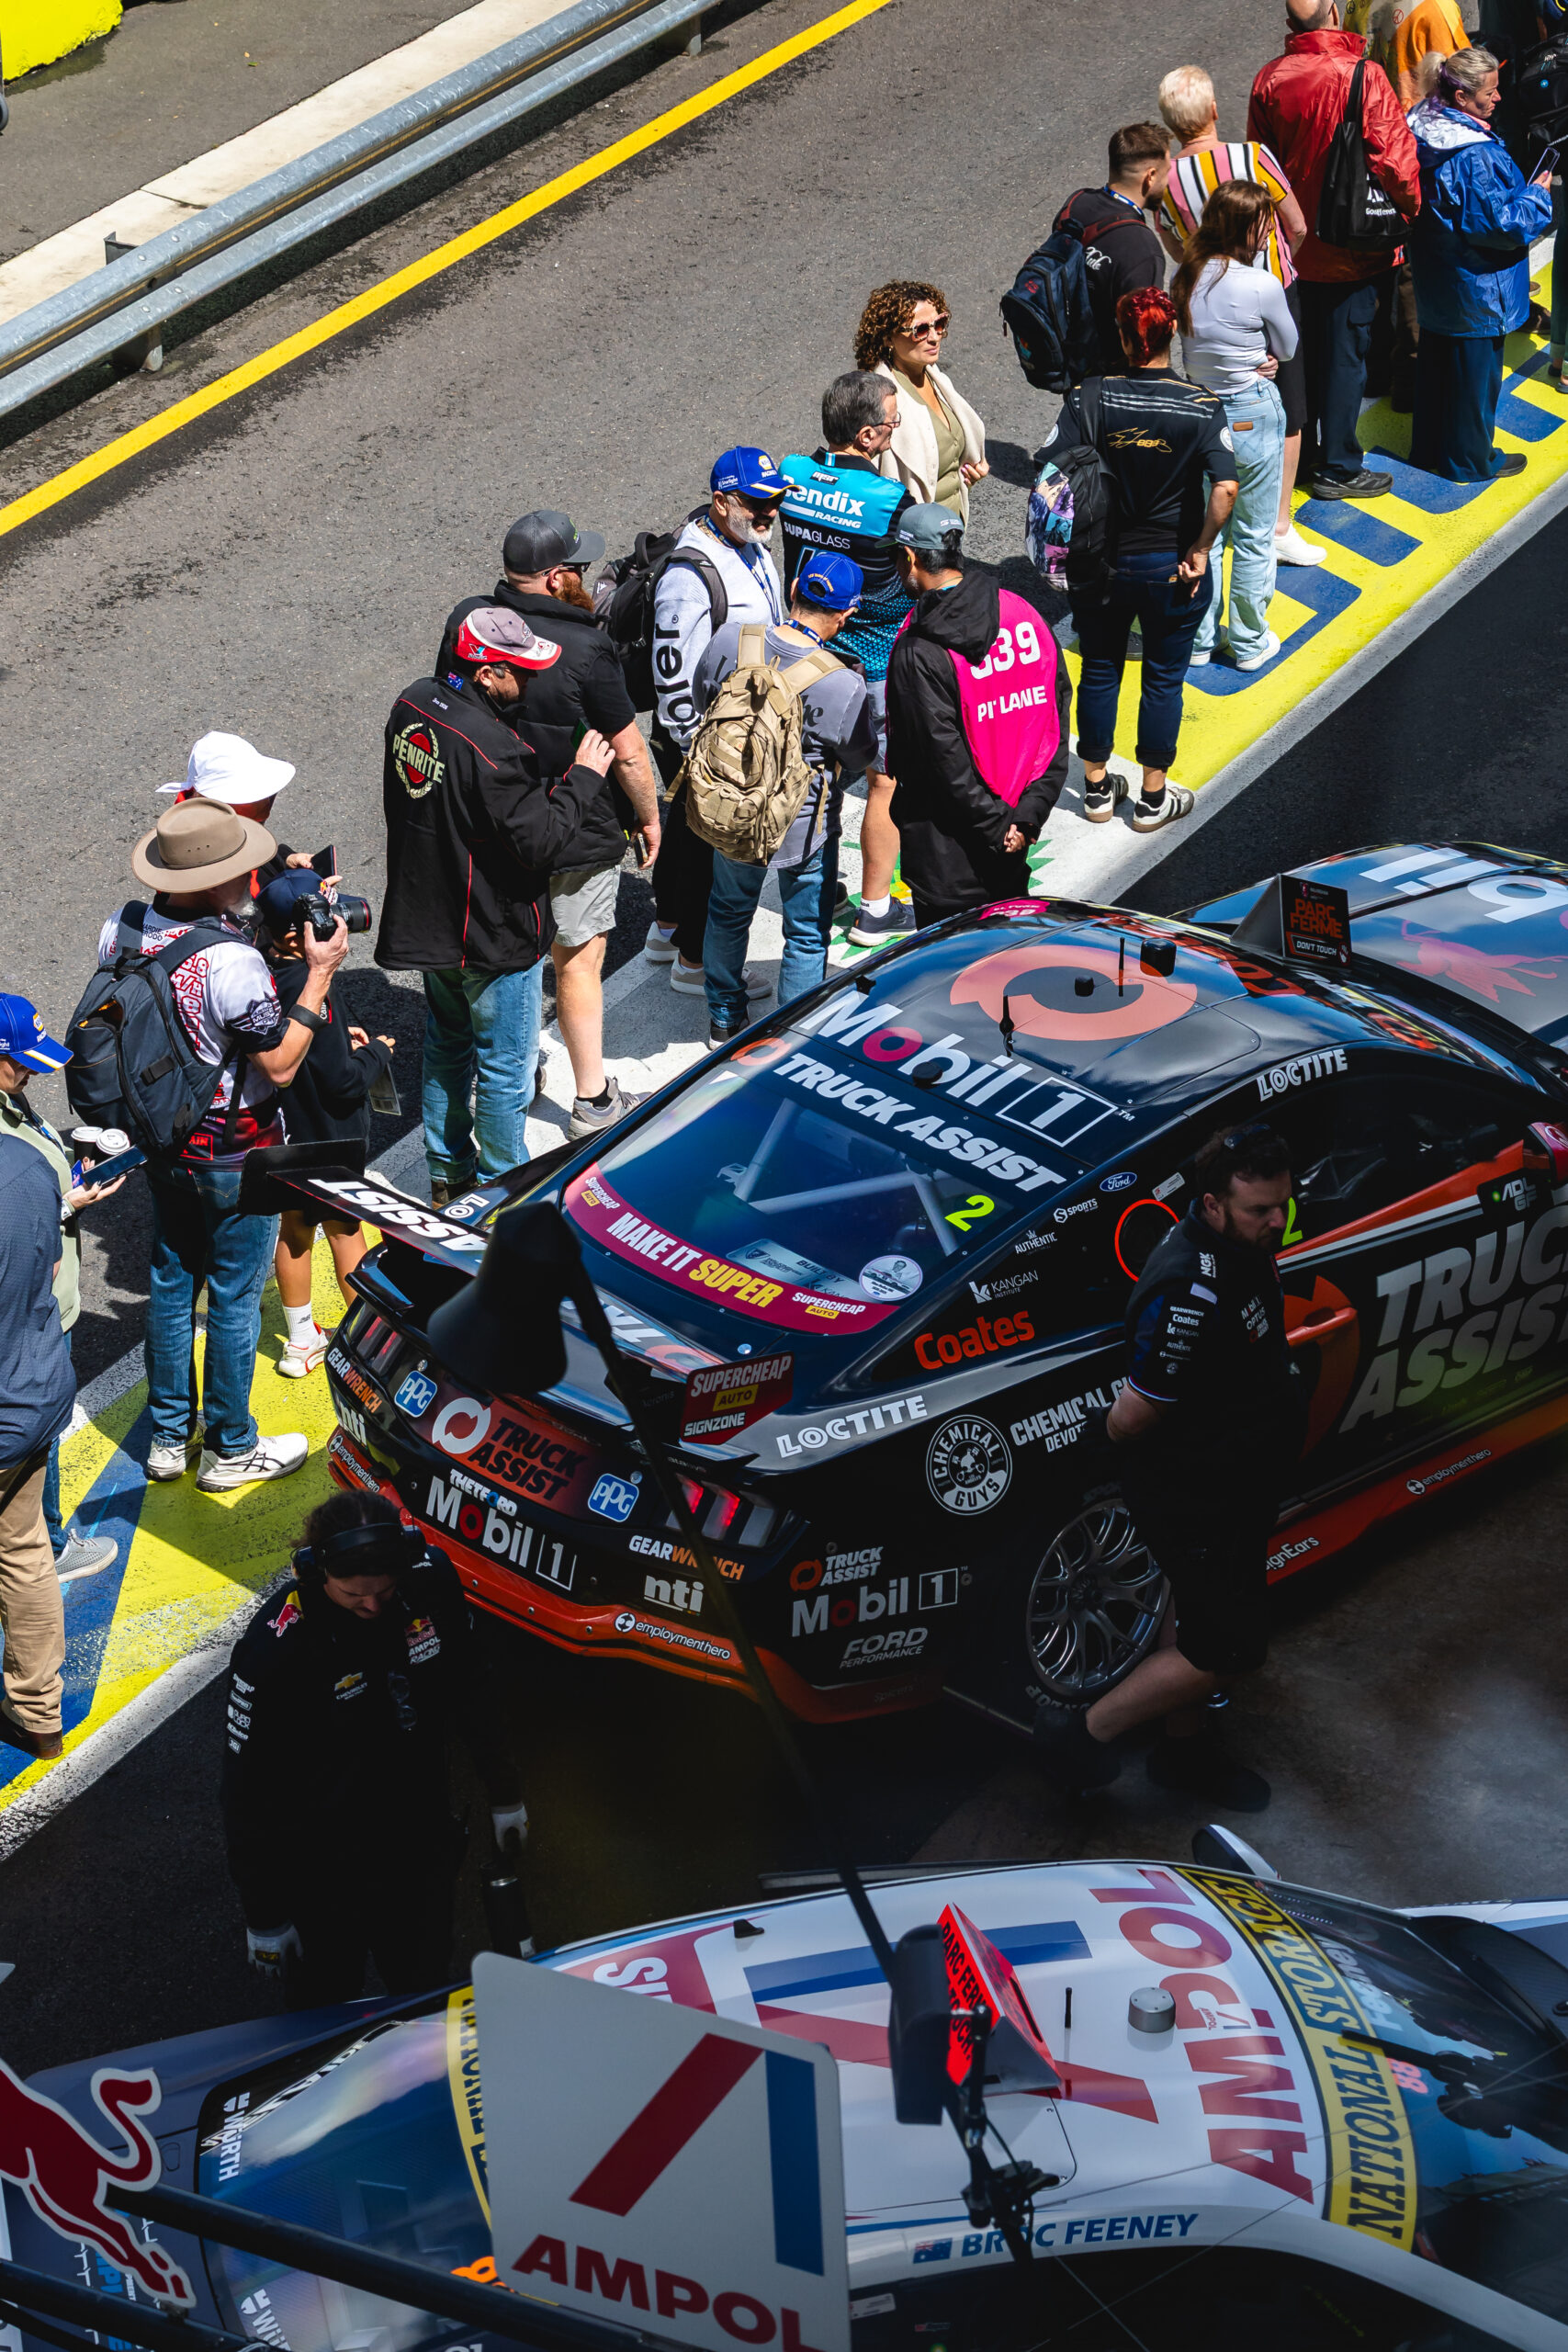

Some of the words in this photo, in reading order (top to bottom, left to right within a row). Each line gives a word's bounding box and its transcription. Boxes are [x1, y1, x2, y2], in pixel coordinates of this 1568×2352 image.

[784, 521, 851, 549] SUPAGLASS
[814, 511, 862, 529] RACING
[999, 685, 1048, 714] LANE
[392, 733, 446, 785] PENRITE
[1290, 912, 1343, 939] FERME
[1294, 899, 1336, 922] PARC
[1296, 940, 1315, 951] DON'T
[1316, 944, 1337, 956] TOUCH
[799, 990, 1033, 1107] Mobil
[1030, 1091, 1087, 1130] 1
[1256, 1048, 1348, 1102] LOCTITE
[773, 1053, 916, 1125] TRUCK
[894, 1114, 1067, 1192] ASSIST
[584, 1192, 598, 1204] AUTO
[585, 1176, 621, 1210] SUPERCHEAP
[1106, 1175, 1131, 1191] Ford
[308, 1179, 489, 1251] ASSIST
[944, 1194, 995, 1232] 2
[1067, 1198, 1098, 1216] SPORTS
[606, 1212, 671, 1263] MAKE
[660, 1244, 703, 1272] IT
[689, 1258, 784, 1308] SUPER
[1014, 1231, 1057, 1255] AUTHENTIC
[1199, 1251, 1213, 1278] NGK
[1377, 1204, 1568, 1347] TRUC
[989, 1270, 1039, 1294] KANGAN
[995, 1286, 1021, 1299] INSTITUTE
[792, 1290, 866, 1317] SUPERCHEAP
[809, 1306, 836, 1318] AUTO
[1169, 1306, 1205, 1317] GEARWRENCH
[1172, 1314, 1200, 1327] Coates
[1246, 1306, 1266, 1330] OPTUS
[914, 1310, 1035, 1370] Coates
[1338, 1282, 1568, 1434] ASSIS
[327, 1347, 383, 1413] GEARWRENCH
[400, 1377, 433, 1407] PPG
[690, 1354, 791, 1397] SUPERCHEAP
[717, 1388, 752, 1408] AUTO
[683, 1412, 746, 1437] SIGNZONE
[776, 1395, 928, 1459] LOCTITE
[1010, 1385, 1112, 1446] CHEMICAL
[490, 1416, 586, 1479] TRUCK
[933, 1423, 1000, 1479] CHEMICAL
[335, 1442, 380, 1494] employmenthero
[467, 1442, 570, 1501] ASSIST
[1421, 1447, 1492, 1487] employmenthero
[449, 1468, 518, 1516] THETFORD
[592, 1481, 636, 1515] PPG
[954, 1476, 1000, 1508] GUYS
[425, 1475, 534, 1568] Mobil
[550, 1542, 564, 1579] 1
[824, 1546, 885, 1571] TRUCK
[1266, 1536, 1320, 1571] ignEars
[820, 1564, 882, 1587] ASSIST
[644, 1575, 705, 1612] nti
[792, 1577, 909, 1638] Mobil
[930, 1574, 944, 1604] 1
[408, 1635, 442, 1657] AMPOL
[635, 1621, 731, 1660] employmenthero
[839, 1645, 925, 1670] PERFORMANCE
[843, 1627, 928, 1655] FORD
[1202, 1876, 1367, 2035] STORAGE
[1198, 2007, 1217, 2030] AMPOL
[1089, 1869, 1314, 2206] AMPOL
[1321, 2041, 1404, 2240] NATIONAL
[961, 2222, 1056, 2258] BRC
[1064, 2212, 1200, 2245] FEENEY
[511, 2233, 829, 2352] AMPOL
